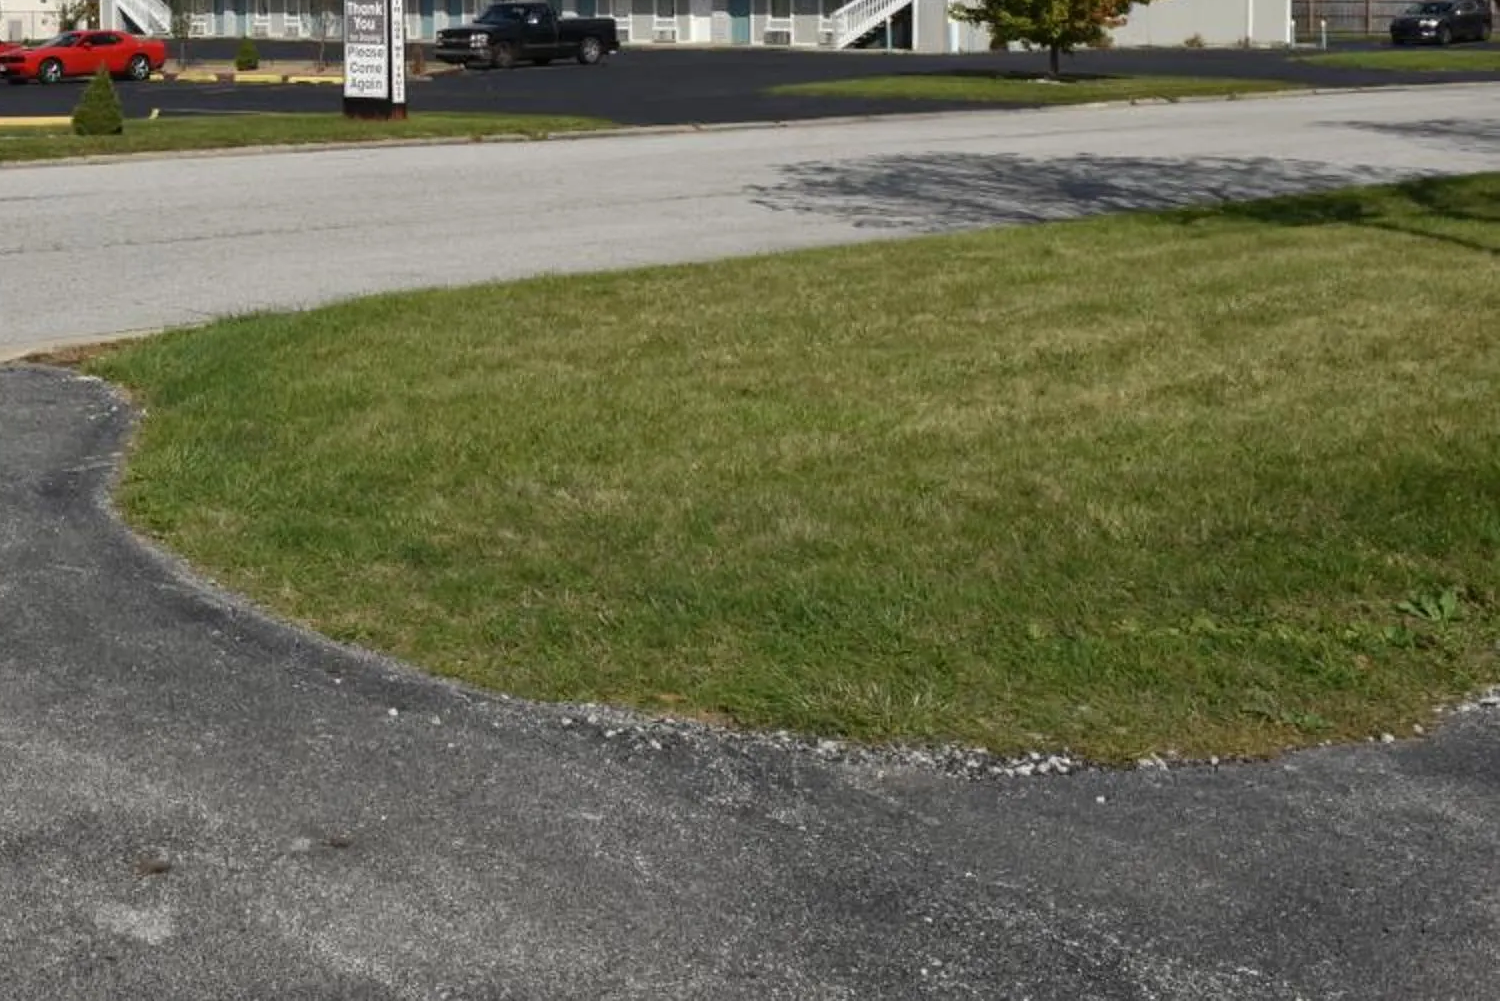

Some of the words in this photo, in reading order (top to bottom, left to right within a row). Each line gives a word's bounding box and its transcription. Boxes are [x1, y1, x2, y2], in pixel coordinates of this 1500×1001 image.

[347, 1, 383, 15] Thank
[353, 16, 376, 30] You
[347, 45, 384, 58] Please
[350, 61, 383, 74] Come
[350, 77, 382, 92] Again
